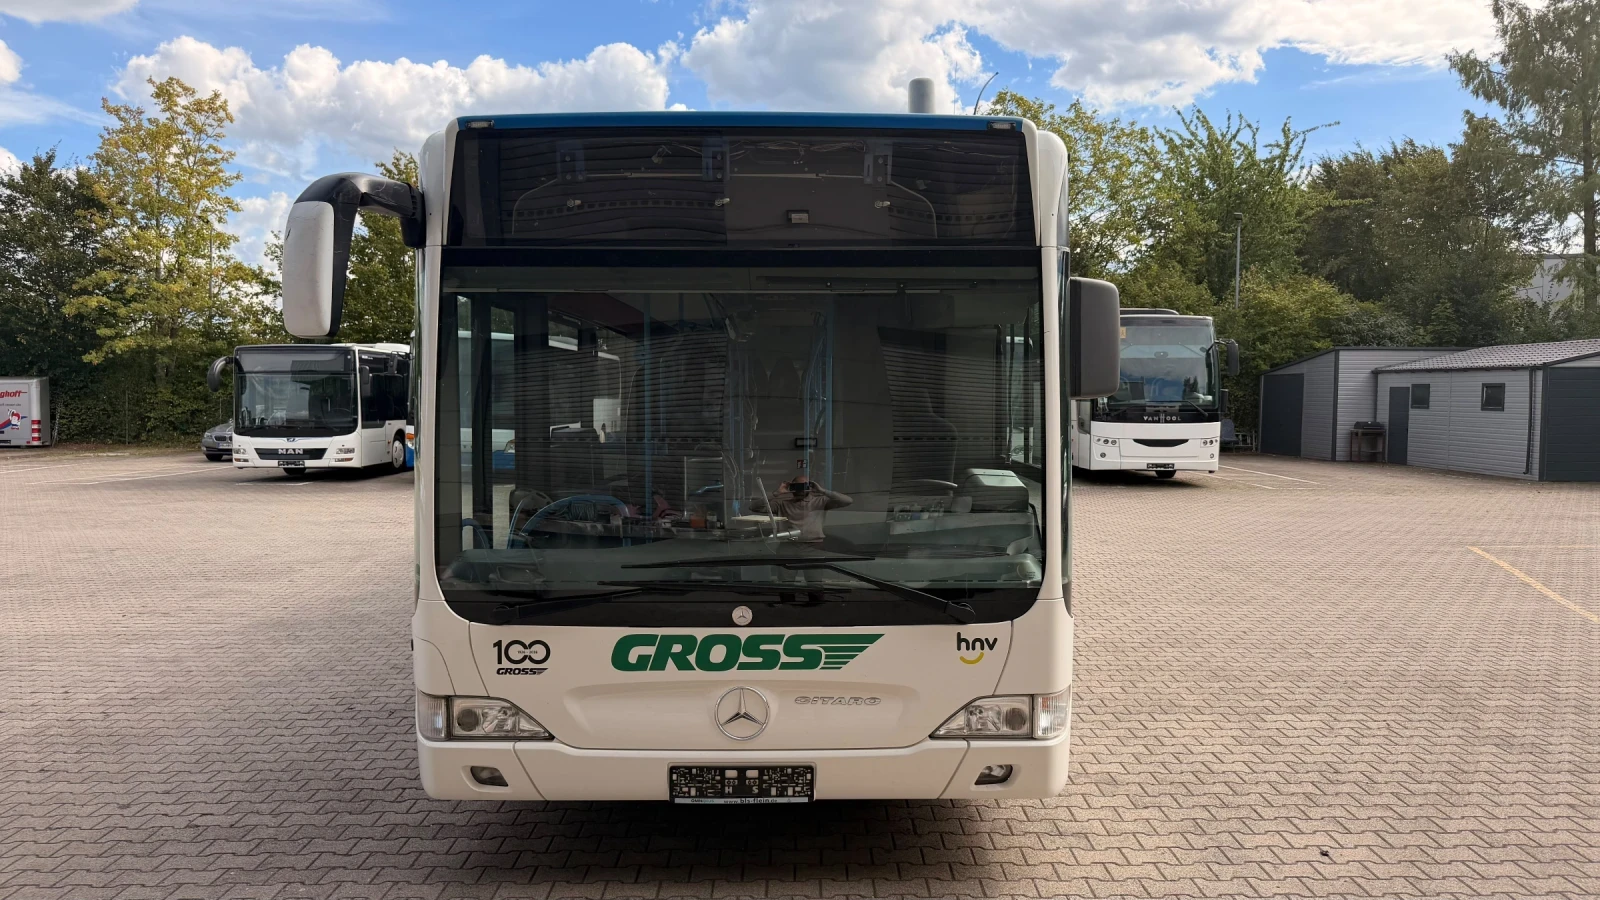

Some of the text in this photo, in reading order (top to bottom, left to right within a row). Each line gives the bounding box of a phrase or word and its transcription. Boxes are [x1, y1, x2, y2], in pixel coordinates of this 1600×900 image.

[956, 632, 998, 651] hnv
[493, 640, 551, 664] 100
[611, 634, 885, 671] GROSS
[496, 667, 549, 675] GROSS
[794, 696, 881, 706] CITARO
